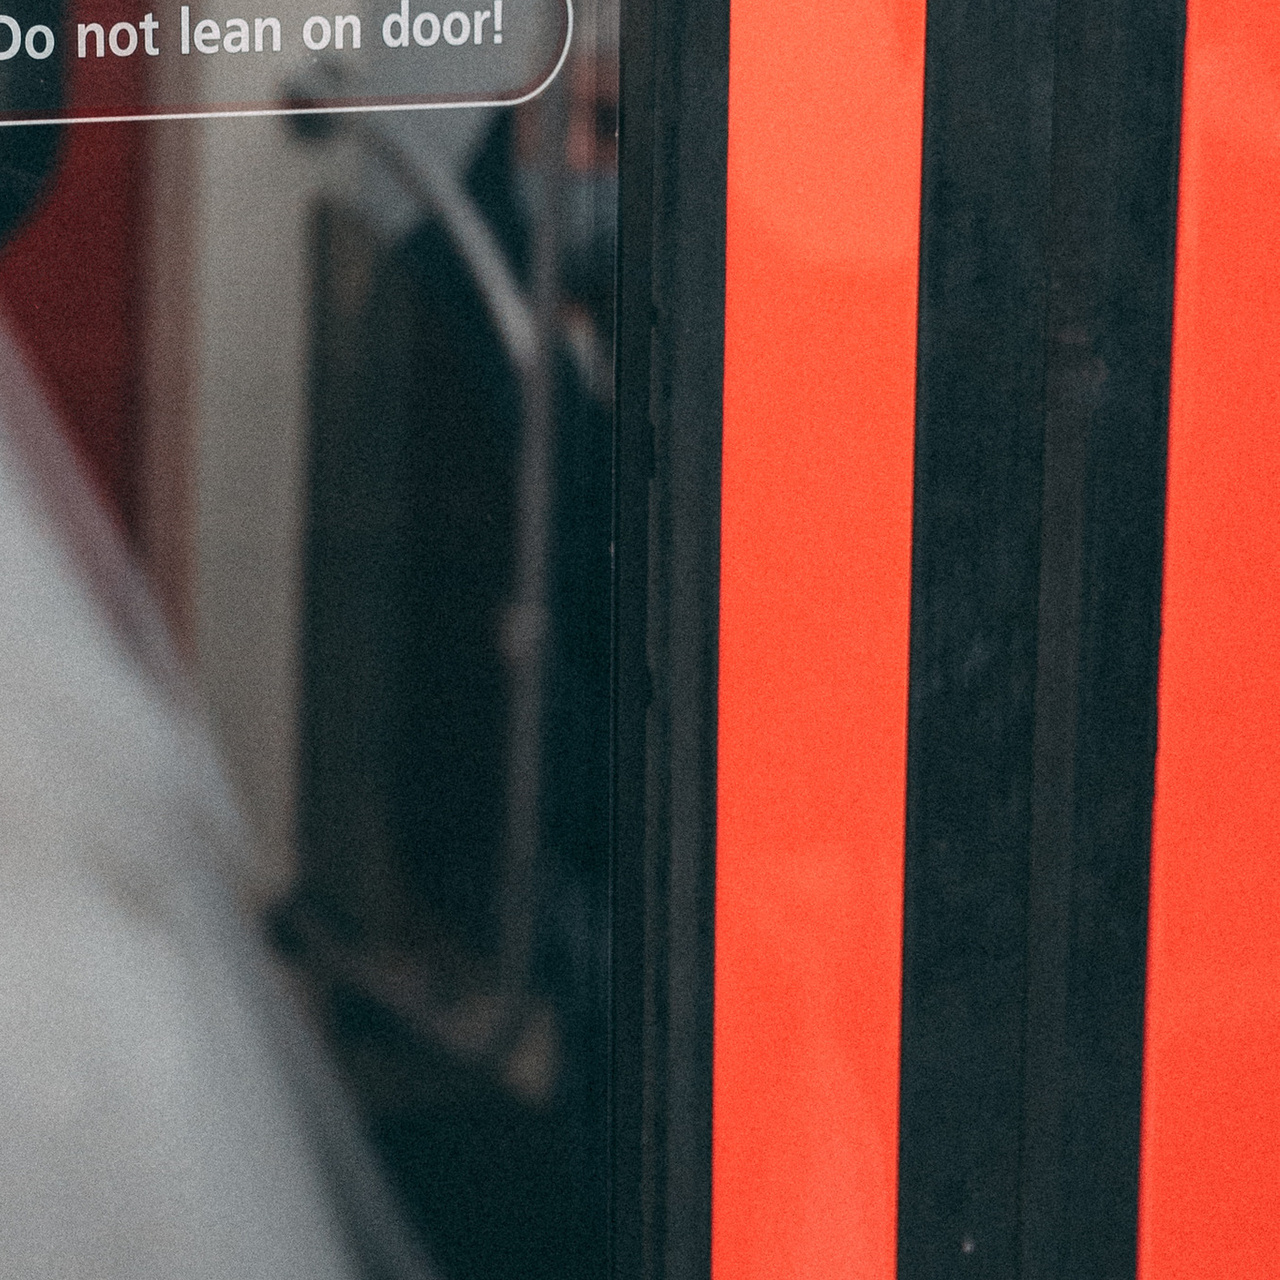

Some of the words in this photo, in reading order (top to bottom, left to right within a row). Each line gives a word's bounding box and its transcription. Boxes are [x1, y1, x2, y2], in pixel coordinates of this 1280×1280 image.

[76, 10, 160, 58] not
[180, 5, 283, 55] lean
[302, 12, 363, 52] on
